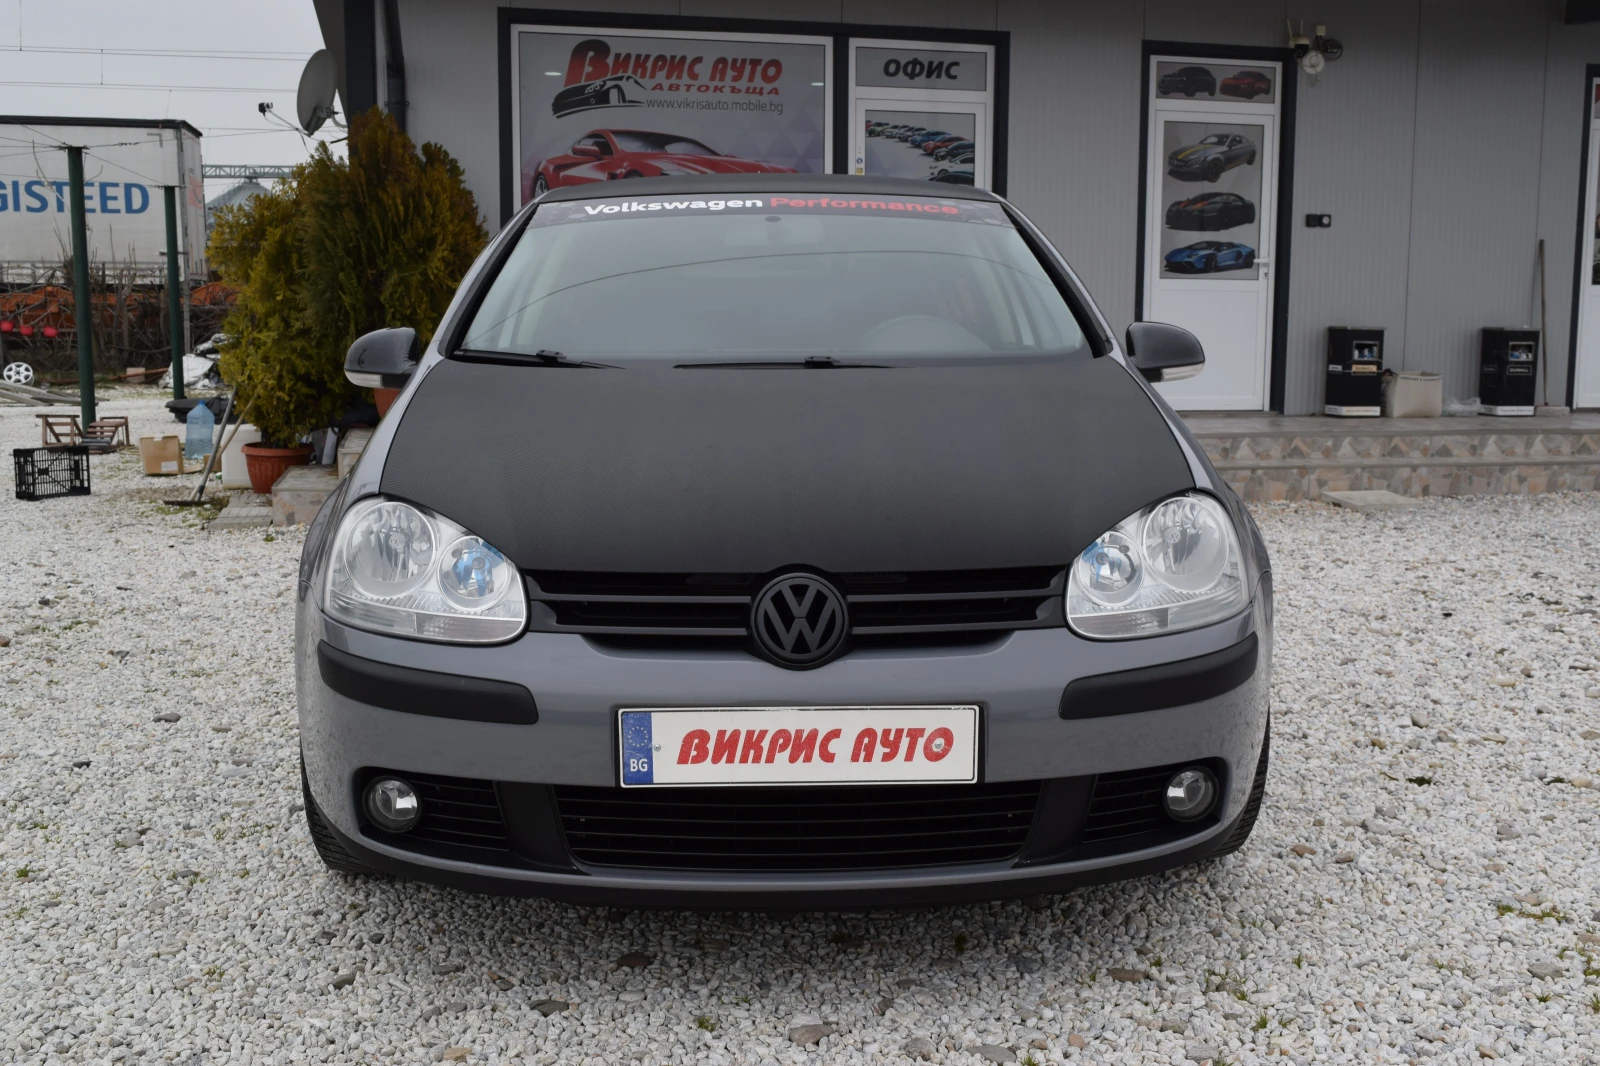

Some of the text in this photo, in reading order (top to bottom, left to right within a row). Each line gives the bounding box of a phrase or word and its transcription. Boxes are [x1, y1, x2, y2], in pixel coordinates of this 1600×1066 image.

[709, 57, 782, 84] АУТО
[883, 58, 960, 80] ОФИС
[650, 82, 780, 96] АВТОКЪЩА
[646, 98, 783, 115] www.vikrisauto.mobile.bg
[585, 197, 959, 215] Volkswagen Performance
[676, 727, 954, 765] ВИКРИС АУТО
[630, 758, 648, 773] BG
